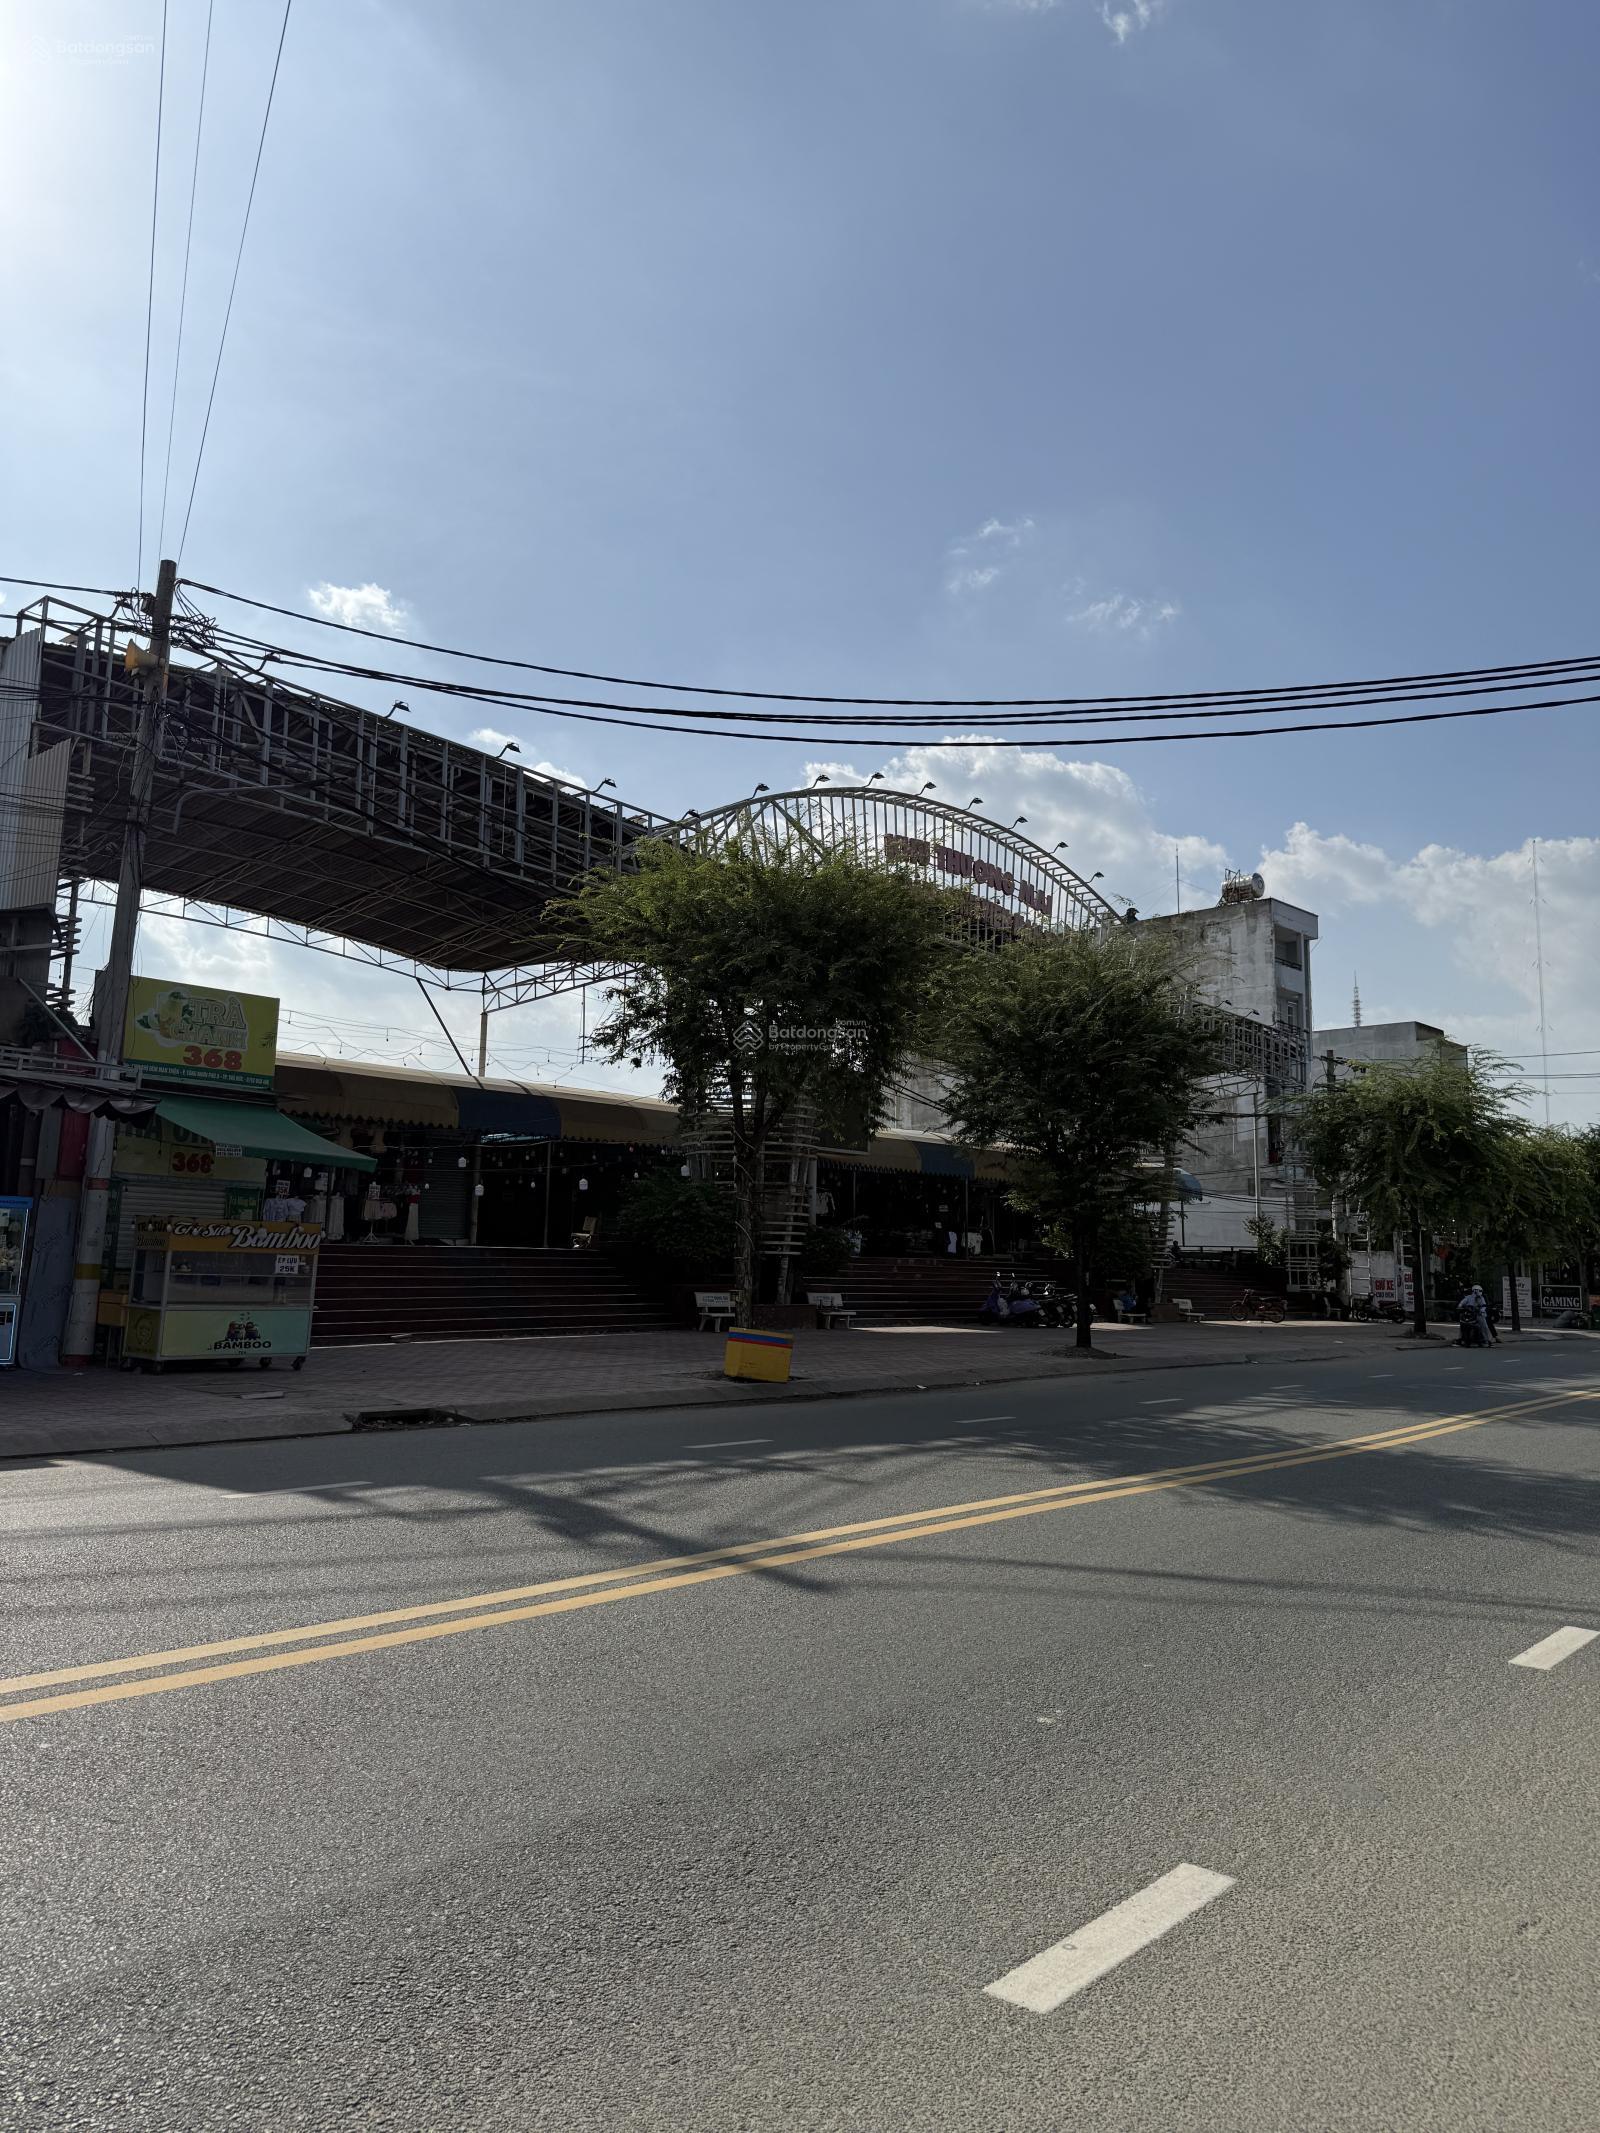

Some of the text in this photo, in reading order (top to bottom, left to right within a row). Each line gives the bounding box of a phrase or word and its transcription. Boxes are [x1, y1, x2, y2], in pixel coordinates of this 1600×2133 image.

[183, 1045, 242, 1070] 368
[172, 1151, 212, 1173] 368
[228, 1224, 320, 1249] Bamboo
[1543, 1296, 1580, 1307] GAMING
[214, 1341, 271, 1350] BAMBOO
